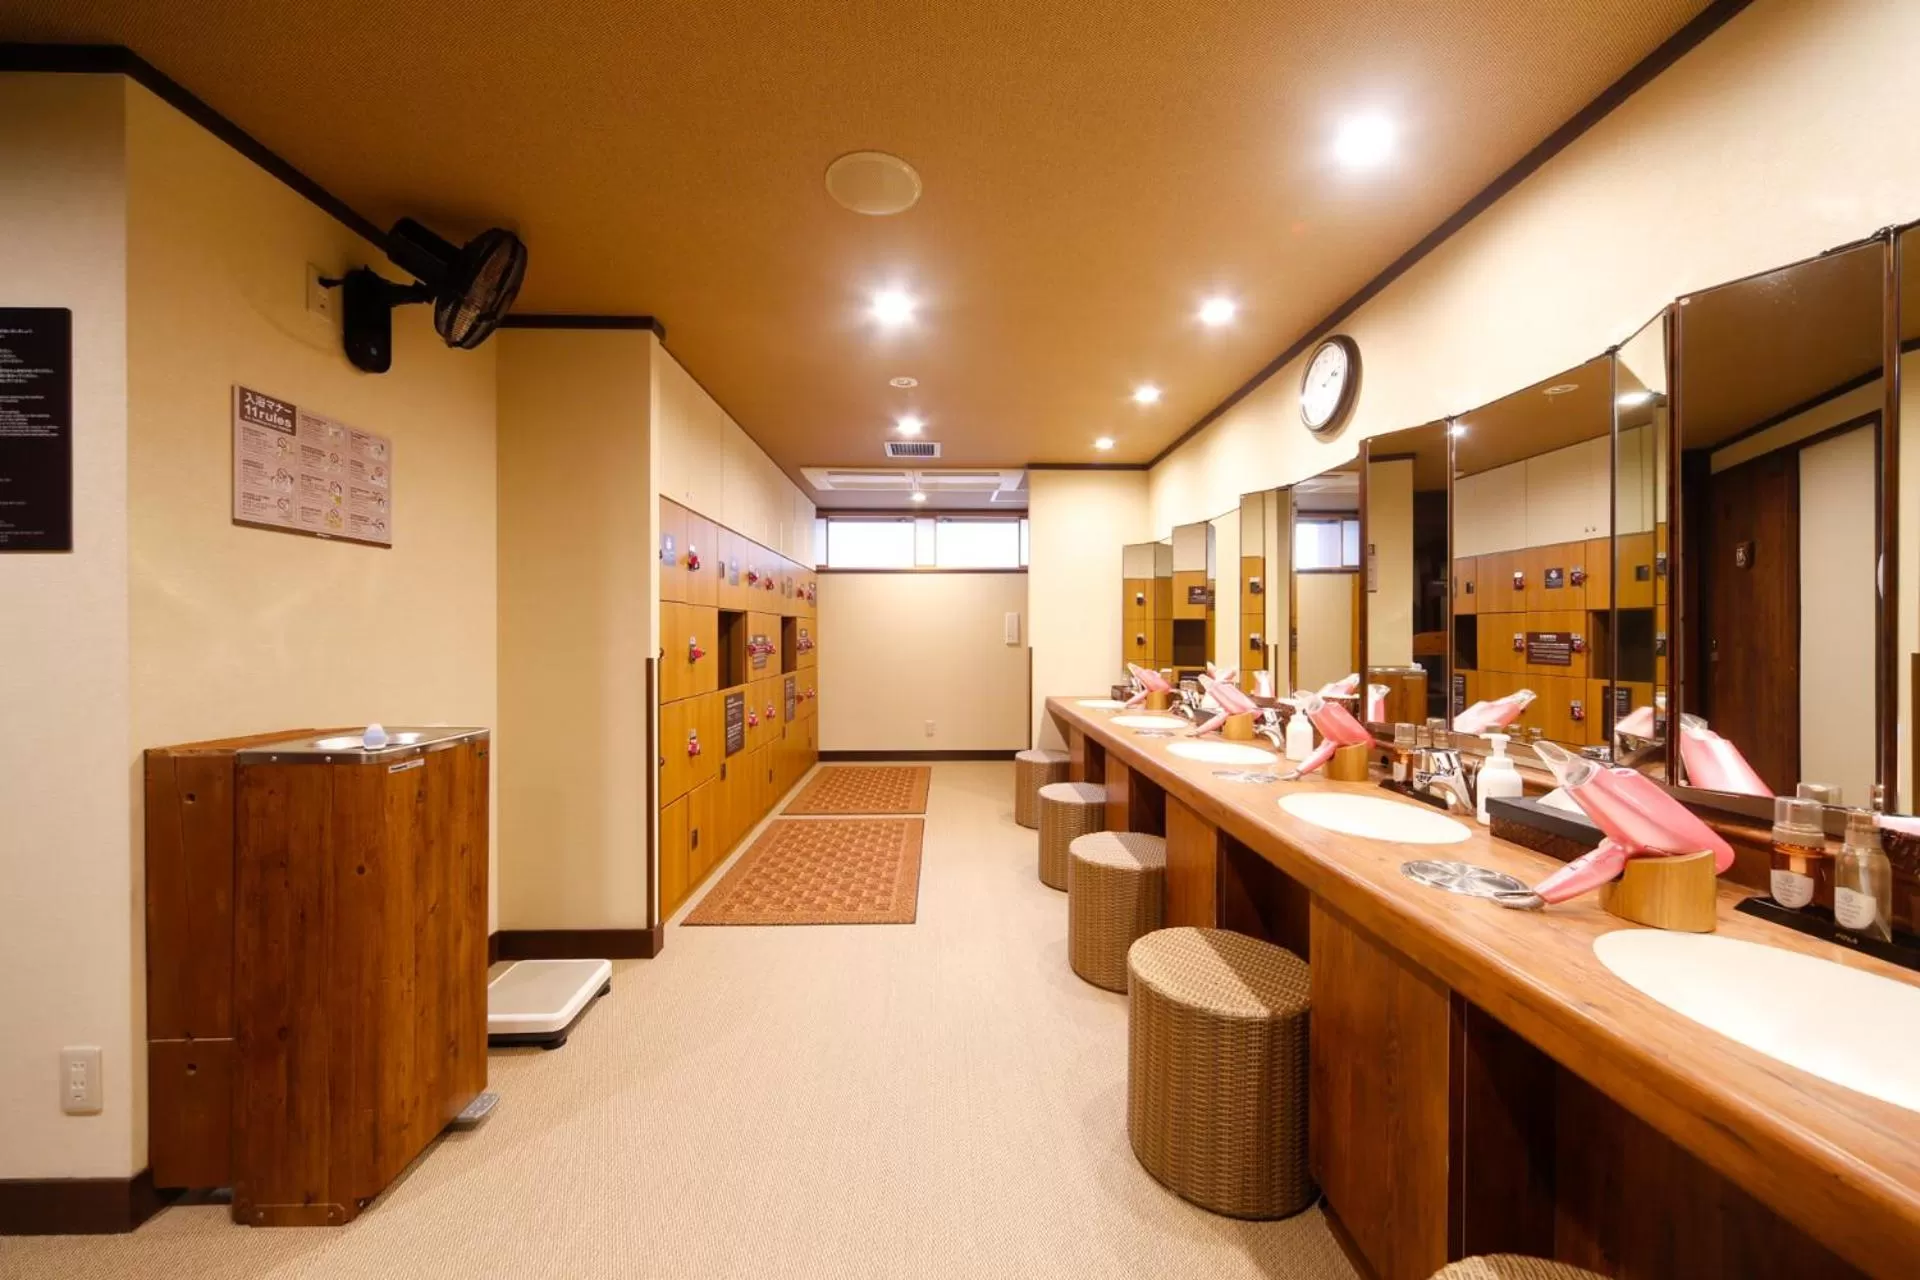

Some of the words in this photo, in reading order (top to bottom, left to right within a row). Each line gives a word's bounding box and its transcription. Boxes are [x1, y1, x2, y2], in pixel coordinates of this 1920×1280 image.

[244, 392, 292, 414] 入浴マナー
